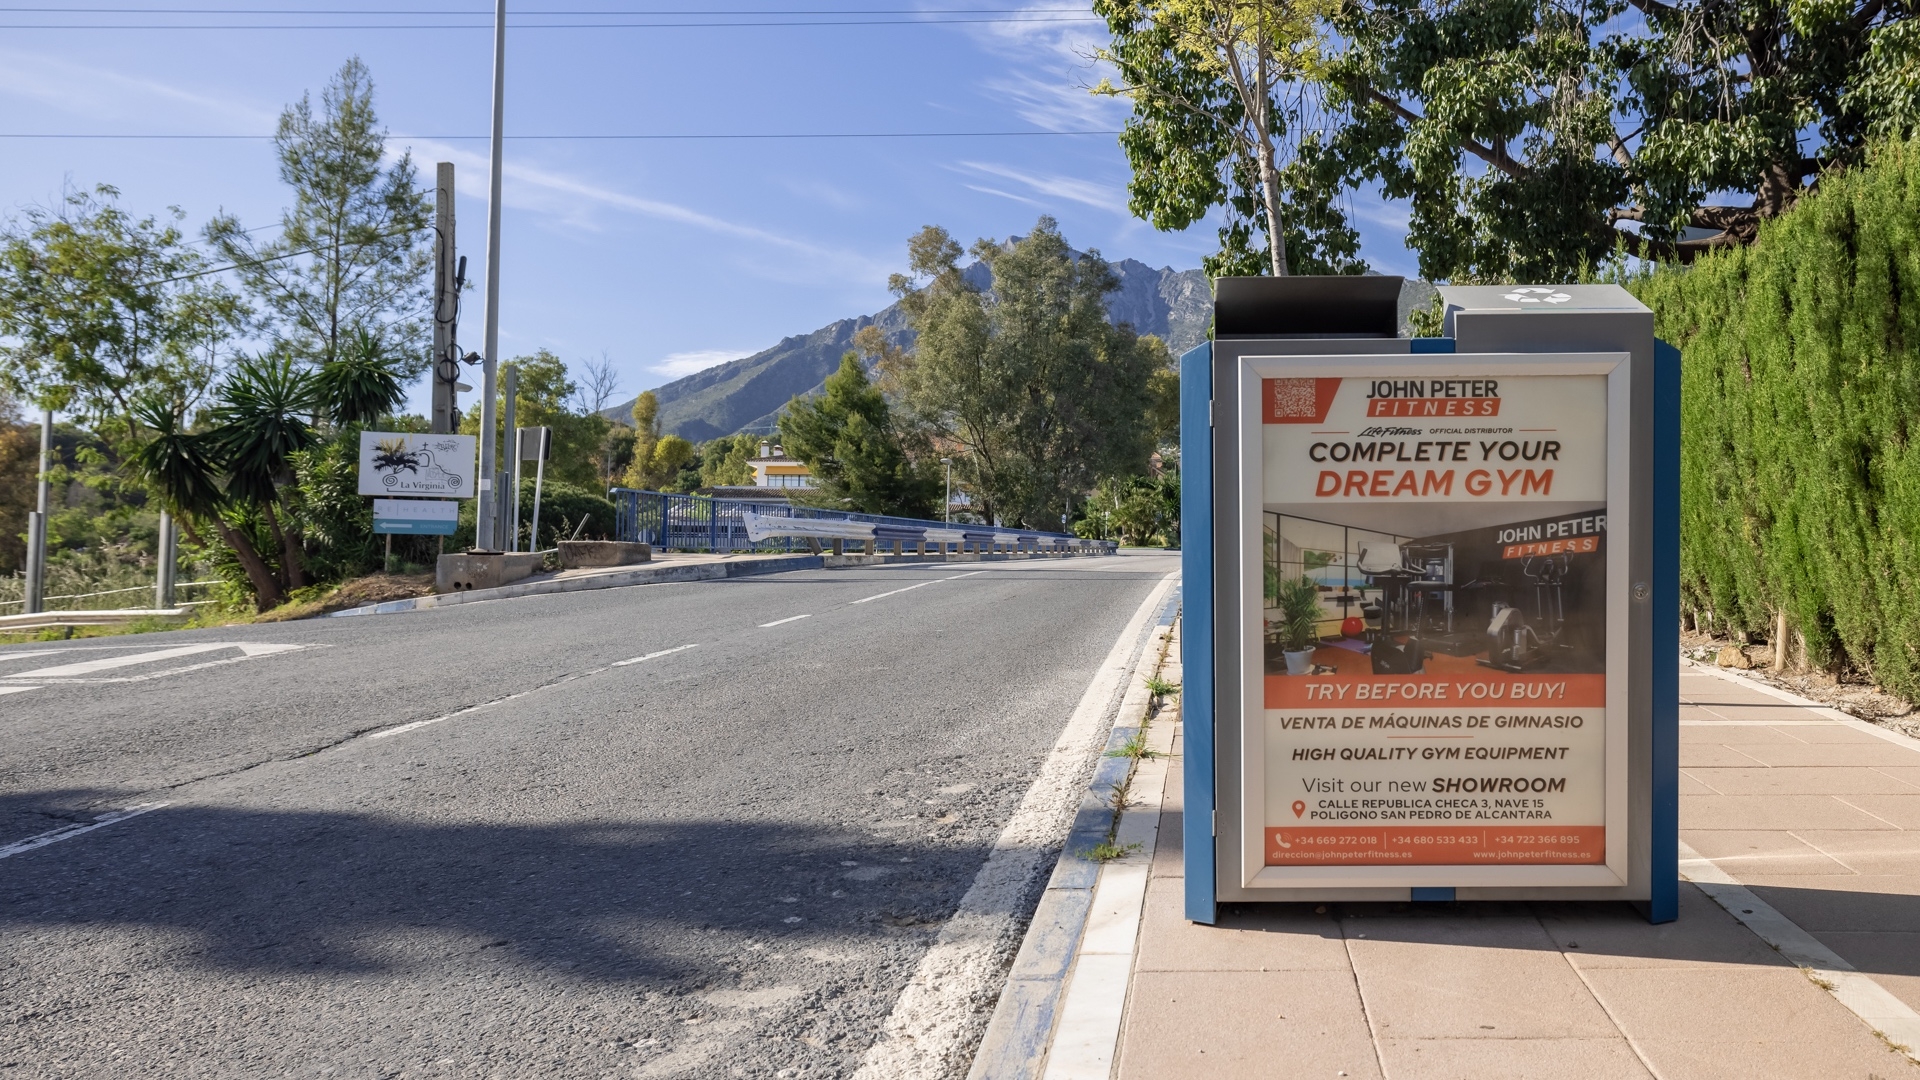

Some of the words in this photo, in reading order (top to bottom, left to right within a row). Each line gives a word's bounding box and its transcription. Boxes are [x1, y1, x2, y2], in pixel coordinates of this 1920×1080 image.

[1366, 380, 1424, 399] JOHN
[1430, 379, 1499, 398] PETER
[1375, 400, 1493, 416] FITNESS
[1429, 427, 1463, 435] OFFICIAL
[1308, 441, 1471, 463] COMPLETE
[1479, 440, 1562, 462] YOUR
[400, 481, 410, 489] La
[412, 481, 445, 491] Virginia
[1314, 469, 1455, 498] DREAM
[1464, 468, 1555, 497] GYM
[1496, 524, 1542, 544] JOHN
[1546, 514, 1607, 538] PETER
[1506, 538, 1593, 557] FITNESS
[1305, 683, 1351, 701] TRY
[1355, 682, 1449, 700] BEFORE
[1456, 682, 1506, 700] YOU
[1510, 681, 1567, 700] BUY!
[1280, 716, 1337, 730] VENTA
[1341, 716, 1366, 729] DE
[1369, 712, 1463, 729] MÁQUINAS
[1466, 715, 1491, 729] DE
[1494, 715, 1584, 729] GIMNASIO
[1291, 748, 1336, 761] HIGH
[1340, 747, 1418, 761] QUALITY
[1421, 747, 1461, 760] GYM
[1464, 747, 1570, 761] EQUIPMENT
[1302, 777, 1345, 793] Visit
[1350, 780, 1382, 793] our
[1388, 780, 1427, 793] new
[1432, 777, 1567, 794] SHOWROOM
[1318, 799, 1359, 809] CALLE
[1361, 799, 1433, 809] REPUBLICA
[1435, 799, 1478, 808] CHECA
[1481, 799, 1492, 810] 3,
[1494, 799, 1530, 808] NAVE
[1532, 799, 1544, 808] 15
[1310, 810, 1378, 820] POLIGONO
[1380, 810, 1406, 820] SAN
[1409, 810, 1453, 820] PEDRO
[1455, 810, 1472, 820] DE
[1474, 810, 1552, 820] ALCANTARA
[1294, 836, 1314, 845] +34
[1316, 836, 1337, 845] 669
[1338, 836, 1358, 845] 272
[1359, 836, 1378, 845] 018
[1391, 836, 1411, 845] +34
[1413, 836, 1434, 845] 680
[1436, 835, 1456, 844] 533
[1458, 835, 1479, 844] 433
[1494, 835, 1514, 844] +34
[1516, 835, 1536, 844] 722
[1537, 835, 1558, 844] 366
[1559, 835, 1580, 844] 895
[1272, 850, 1413, 860] direccion@johnpeterfitness.es
[1473, 849, 1591, 860] www.johnpeterfitness.es
